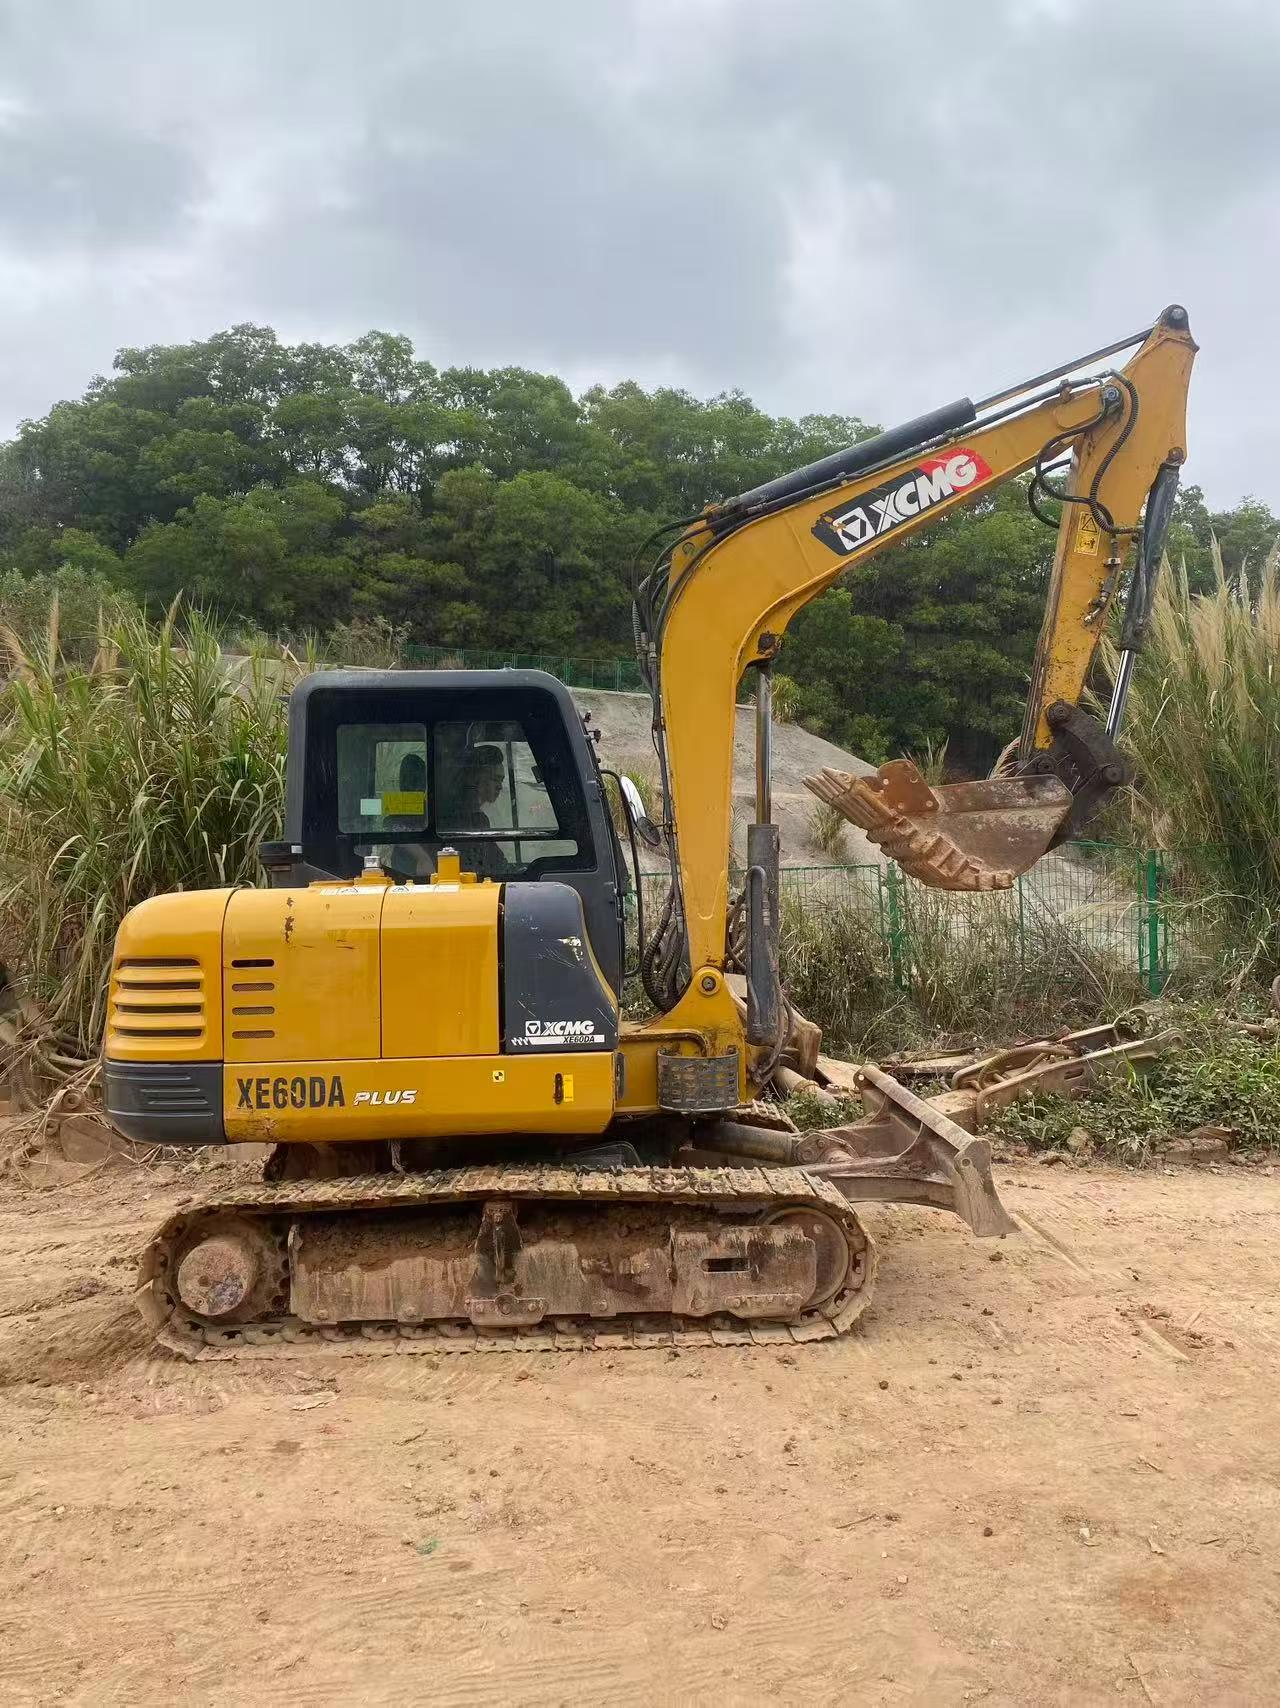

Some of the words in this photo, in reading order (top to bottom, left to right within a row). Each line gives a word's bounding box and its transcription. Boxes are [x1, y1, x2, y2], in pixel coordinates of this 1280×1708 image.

[869, 455, 977, 534] XCMG
[540, 1020, 595, 1036] XCMG
[563, 1035, 595, 1043] XE60DA
[236, 1076, 345, 1110] XE60DA
[353, 1090, 418, 1106] PLUS
